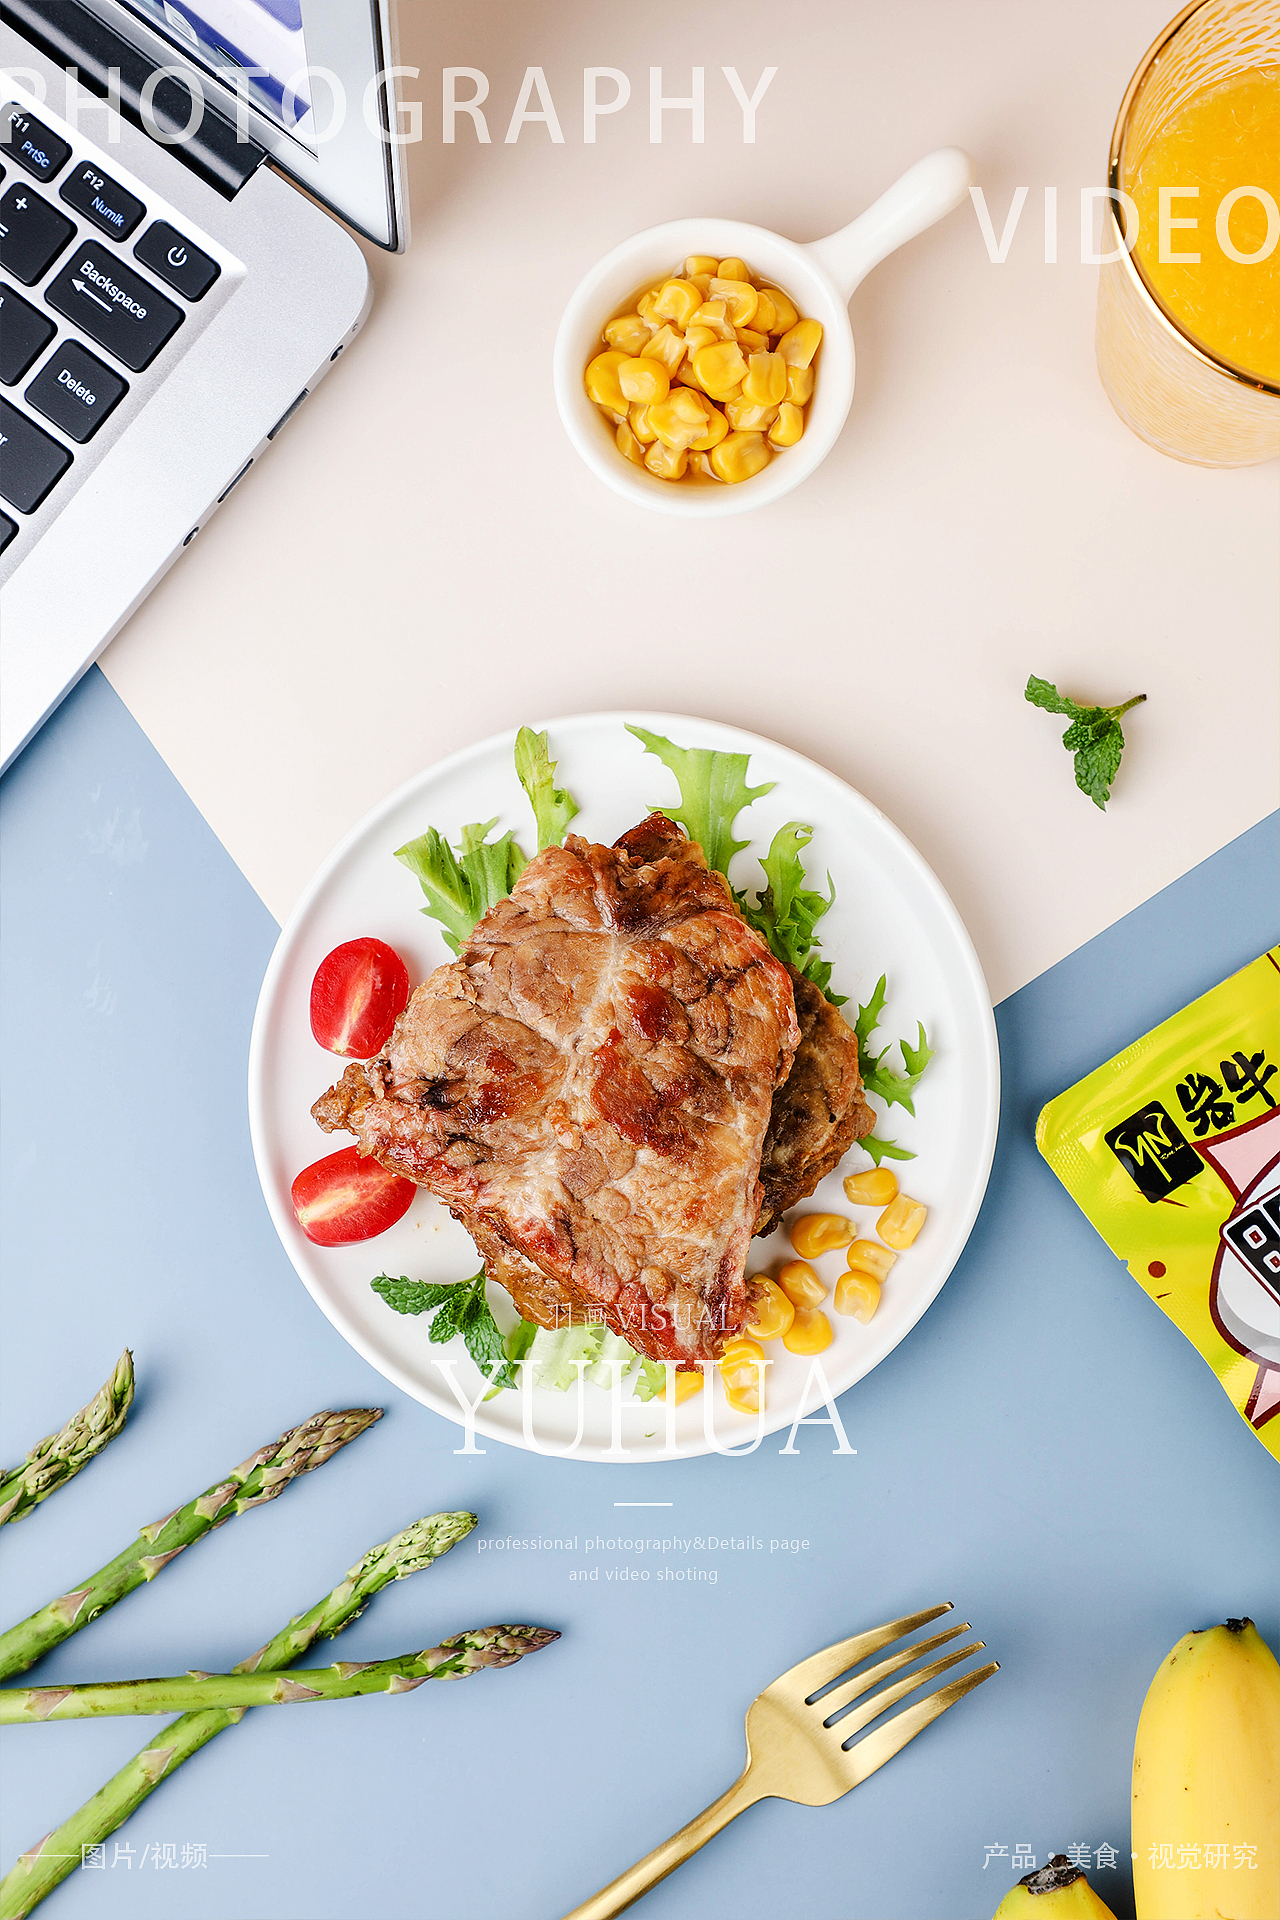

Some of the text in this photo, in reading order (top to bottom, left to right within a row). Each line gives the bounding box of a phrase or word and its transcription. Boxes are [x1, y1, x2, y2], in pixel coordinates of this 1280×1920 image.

[7, 111, 30, 133] F11
[21, 140, 50, 168] PrtSc
[82, 169, 105, 191] F12
[79, 260, 148, 320] Backspace
[57, 368, 97, 406] Delete
